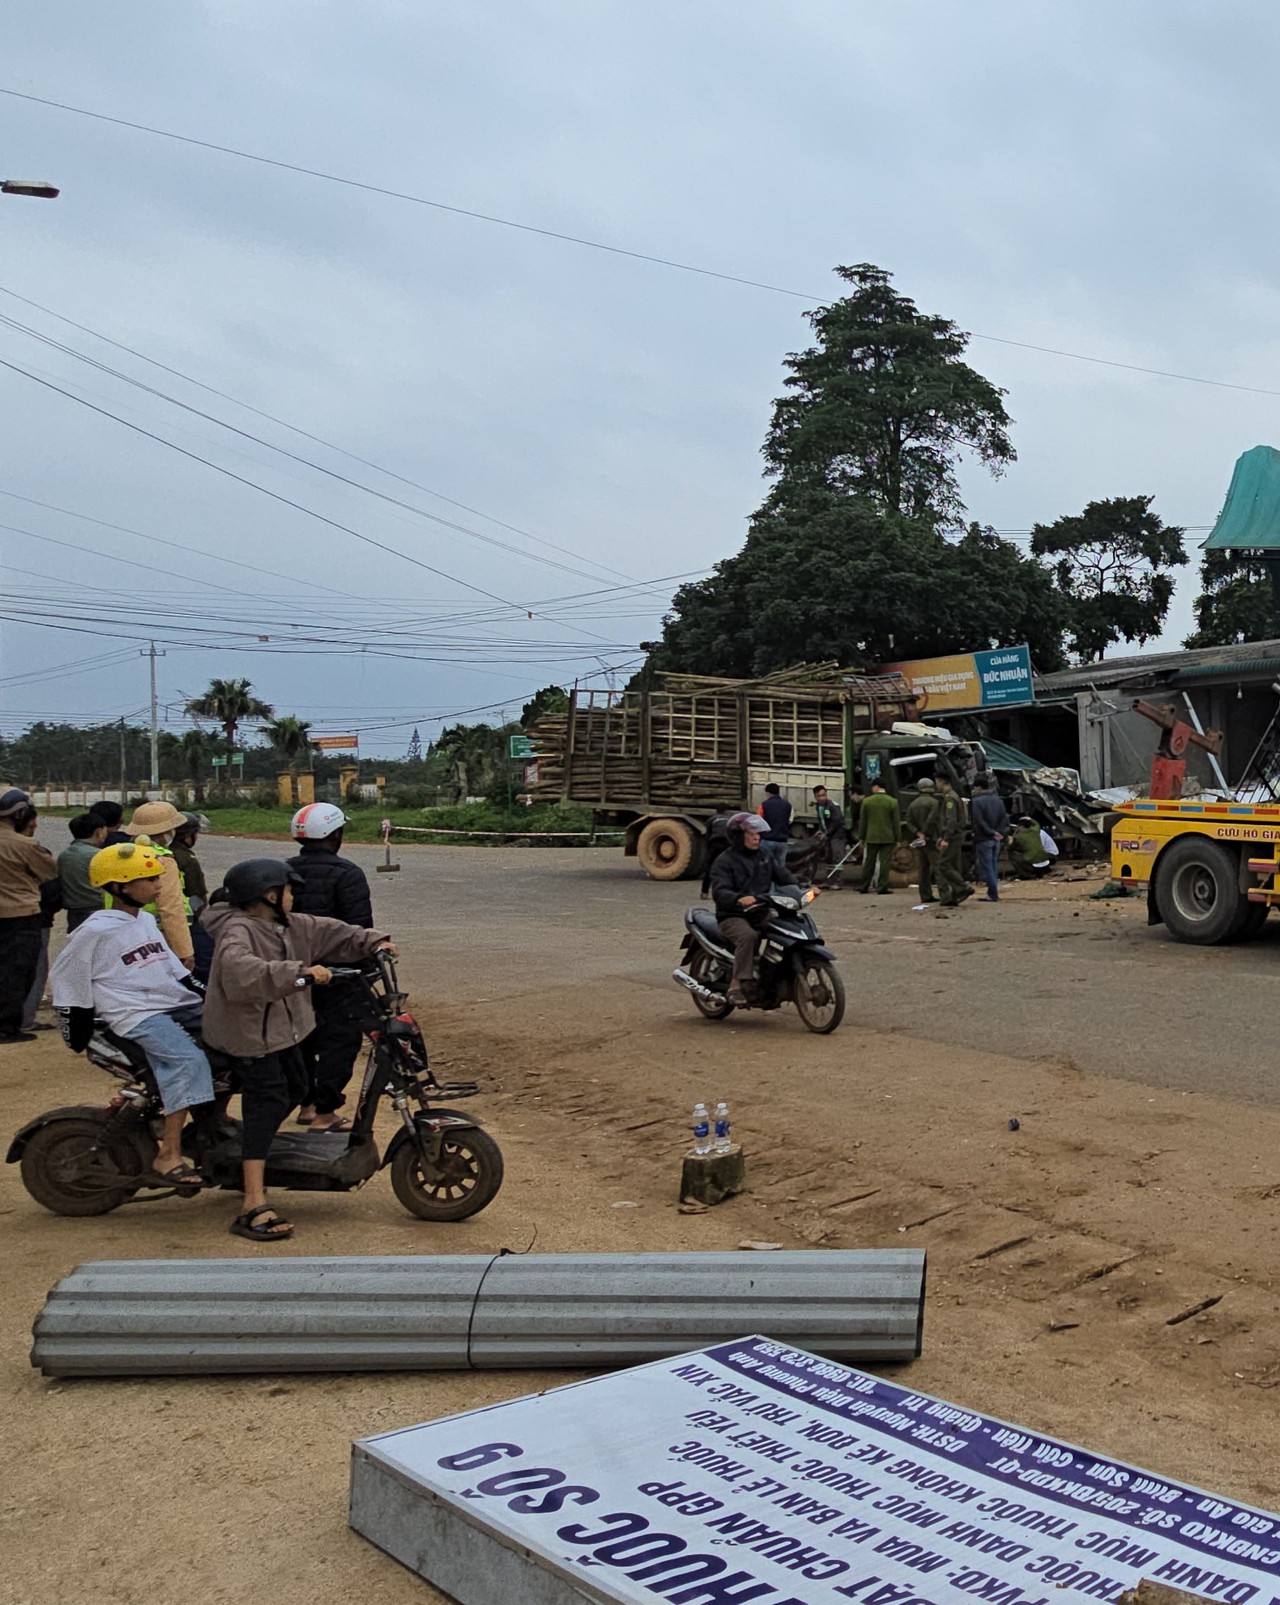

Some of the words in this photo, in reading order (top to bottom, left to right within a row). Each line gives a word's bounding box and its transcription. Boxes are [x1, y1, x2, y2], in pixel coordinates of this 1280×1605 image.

[983, 670, 1000, 683] ĐỨC
[1000, 667, 1028, 682] NHUẬN
[669, 1363, 722, 1387] XIN
[728, 1351, 758, 1369] Anh
[759, 1364, 813, 1396] Phương
[811, 1386, 854, 1409] Diệu
[684, 1409, 740, 1434] YẾU
[744, 1401, 803, 1427] TRỪ
[850, 1400, 916, 1432] Nguyễn
[924, 1399, 983, 1433] Quảng
[725, 1430, 803, 1464] THIẾT
[844, 1443, 896, 1466] KÊ
[912, 1424, 969, 1454] DSTH:
[991, 1428, 1034, 1454] Tiên
[667, 1441, 755, 1482] THUỐC
[448, 1467, 601, 1515] SỐ
[731, 1476, 790, 1498] LẺ
[790, 1459, 882, 1501] THUỐC
[884, 1459, 986, 1504] KHÔNG
[637, 1480, 725, 1516] GPP
[771, 1492, 845, 1525] BÁN
[872, 1495, 950, 1529] MỤC
[1195, 1498, 1233, 1520] An
[827, 1517, 882, 1544] VÀ
[976, 1497, 1079, 1540] THUỐC
[1134, 1506, 1182, 1529] SỐ:
[1231, 1512, 1274, 1534] Gio
[703, 1512, 851, 1580] CHUẨN
[872, 1535, 953, 1574] MUA
[936, 1521, 1034, 1563] DANH
[1074, 1531, 1161, 1569] MỤC
[556, 1512, 809, 1605] HUỐC
[1152, 1558, 1262, 1605] DANH
